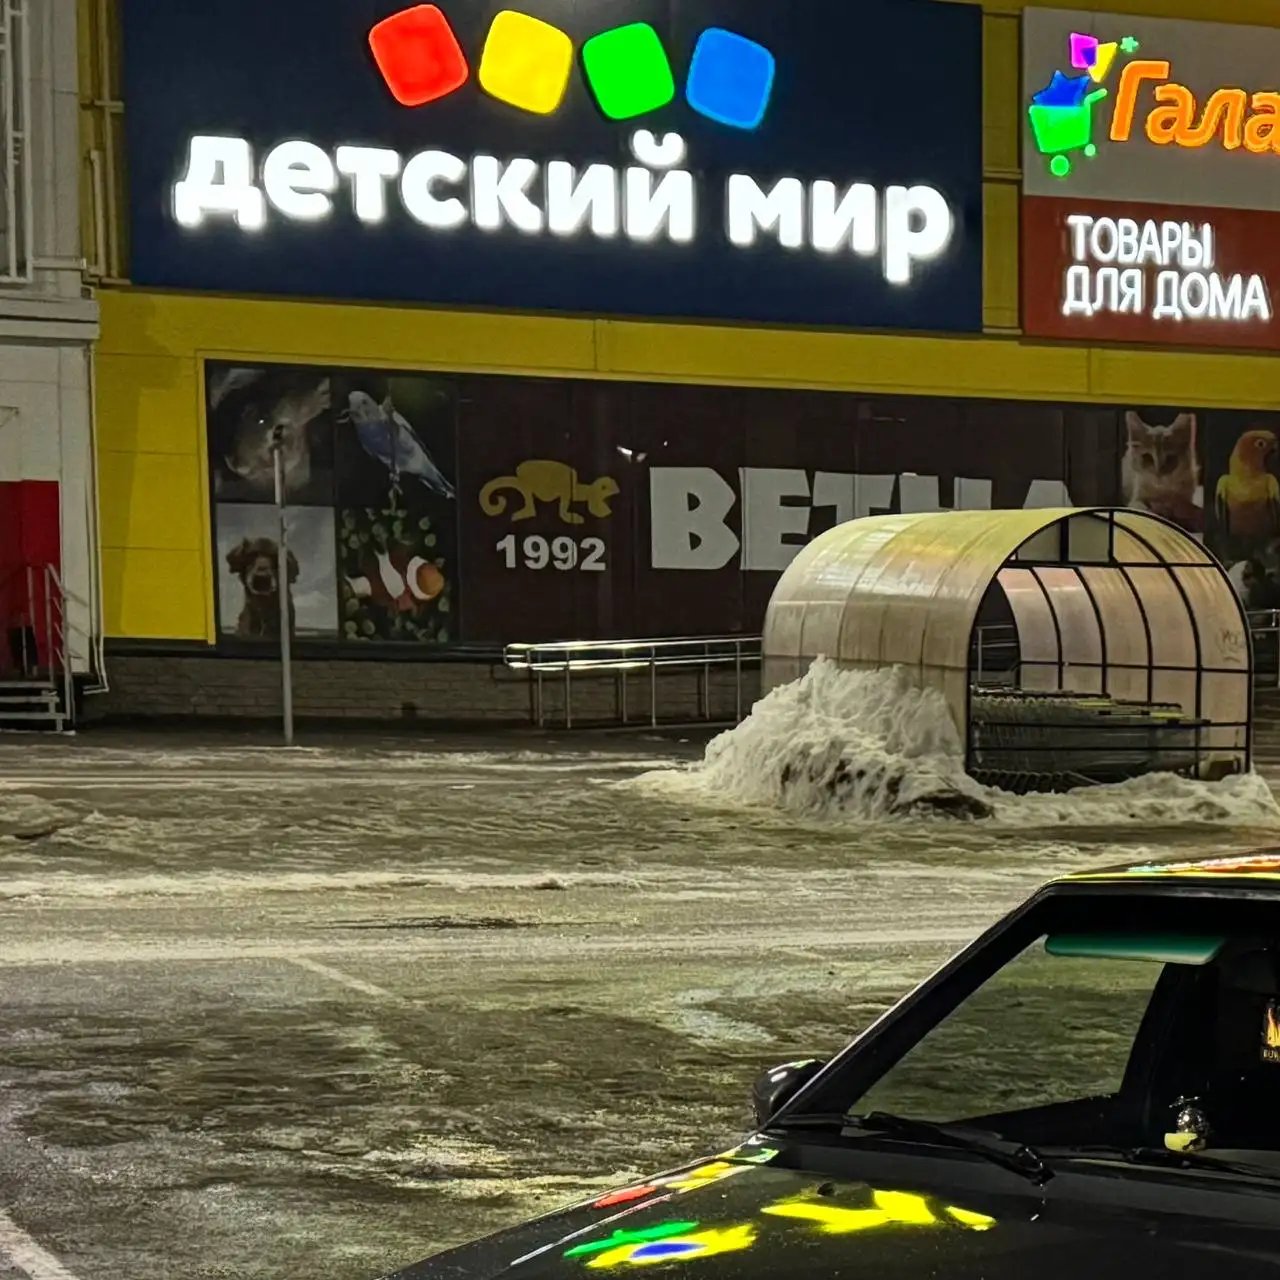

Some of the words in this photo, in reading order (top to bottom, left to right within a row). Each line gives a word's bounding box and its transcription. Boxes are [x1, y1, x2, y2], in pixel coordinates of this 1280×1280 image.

[173, 129, 695, 241] детский
[728, 174, 953, 284] мир
[1066, 214, 1214, 269] ТОВАРЫ
[1062, 266, 1142, 317] ДЛЯ
[1153, 270, 1271, 321] ДОМА
[495, 534, 607, 572] 1992
